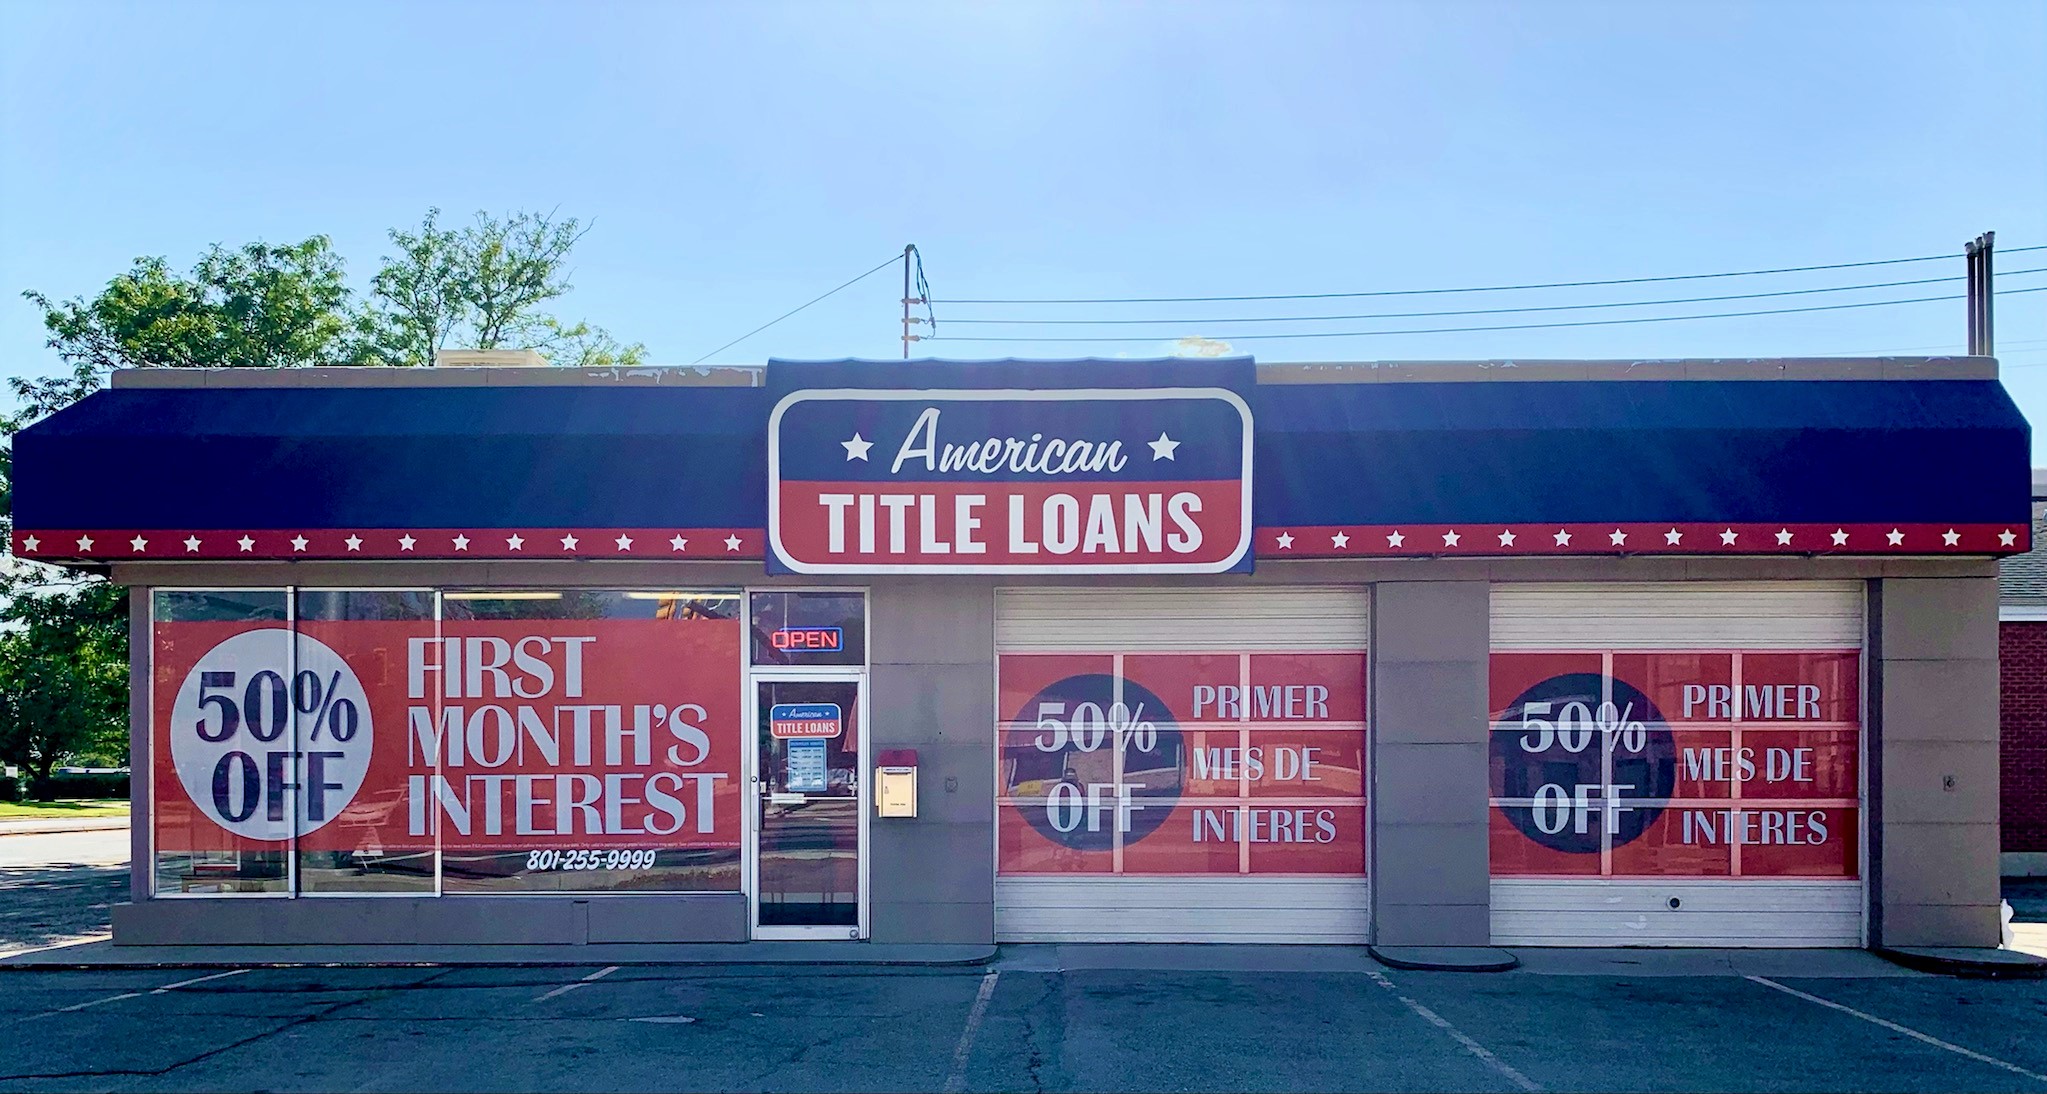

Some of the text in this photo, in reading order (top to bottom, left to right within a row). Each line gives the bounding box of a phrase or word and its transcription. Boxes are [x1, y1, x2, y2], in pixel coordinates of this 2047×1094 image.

[891, 407, 1128, 474] American
[819, 492, 1203, 554] TITLE LOANS
[772, 631, 837, 648] OPEN
[408, 636, 596, 699] FIRST
[195, 669, 358, 743] 50%
[789, 708, 822, 718] American
[1034, 701, 1158, 752] 50%
[1193, 685, 1329, 718] PRIMER
[1519, 701, 1647, 753] 50%
[1683, 685, 1821, 718] PRIMER
[408, 703, 711, 768] MONTH'S
[777, 722, 835, 734] TITLE LOANS
[211, 750, 345, 823] OFF
[1193, 747, 1321, 781] MES DE
[1683, 748, 1813, 782] MES DE
[408, 772, 729, 837] INTEREST
[1046, 782, 1146, 833] OFF
[1193, 809, 1337, 843] INTERES
[1532, 783, 1635, 834] OFF
[1683, 811, 1828, 845] INTERES
[526, 849, 656, 871] 801-255-9999
